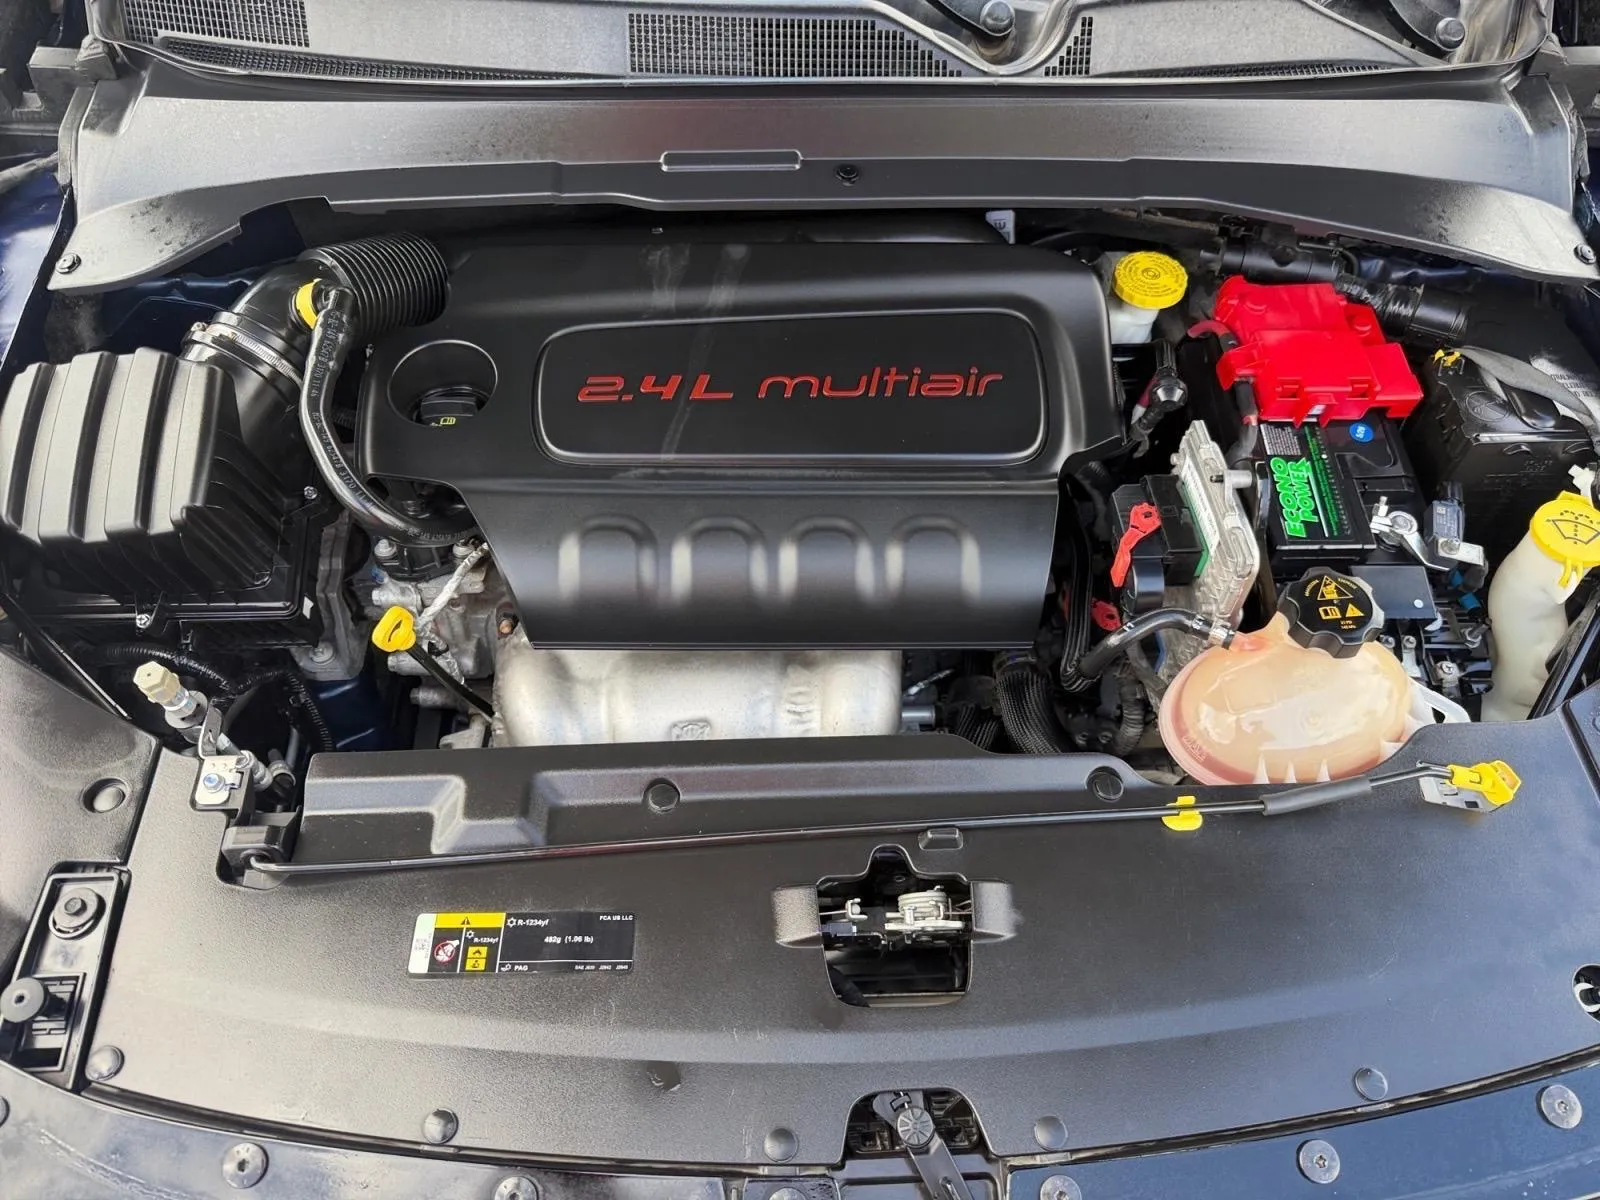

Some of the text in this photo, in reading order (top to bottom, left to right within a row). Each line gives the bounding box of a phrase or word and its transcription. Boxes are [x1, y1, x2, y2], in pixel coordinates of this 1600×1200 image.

[758, 366, 1003, 398] multiair
[1270, 457, 1306, 538] ECONO
[1288, 457, 1319, 522] POWER
[517, 918, 550, 928] R-1234yf
